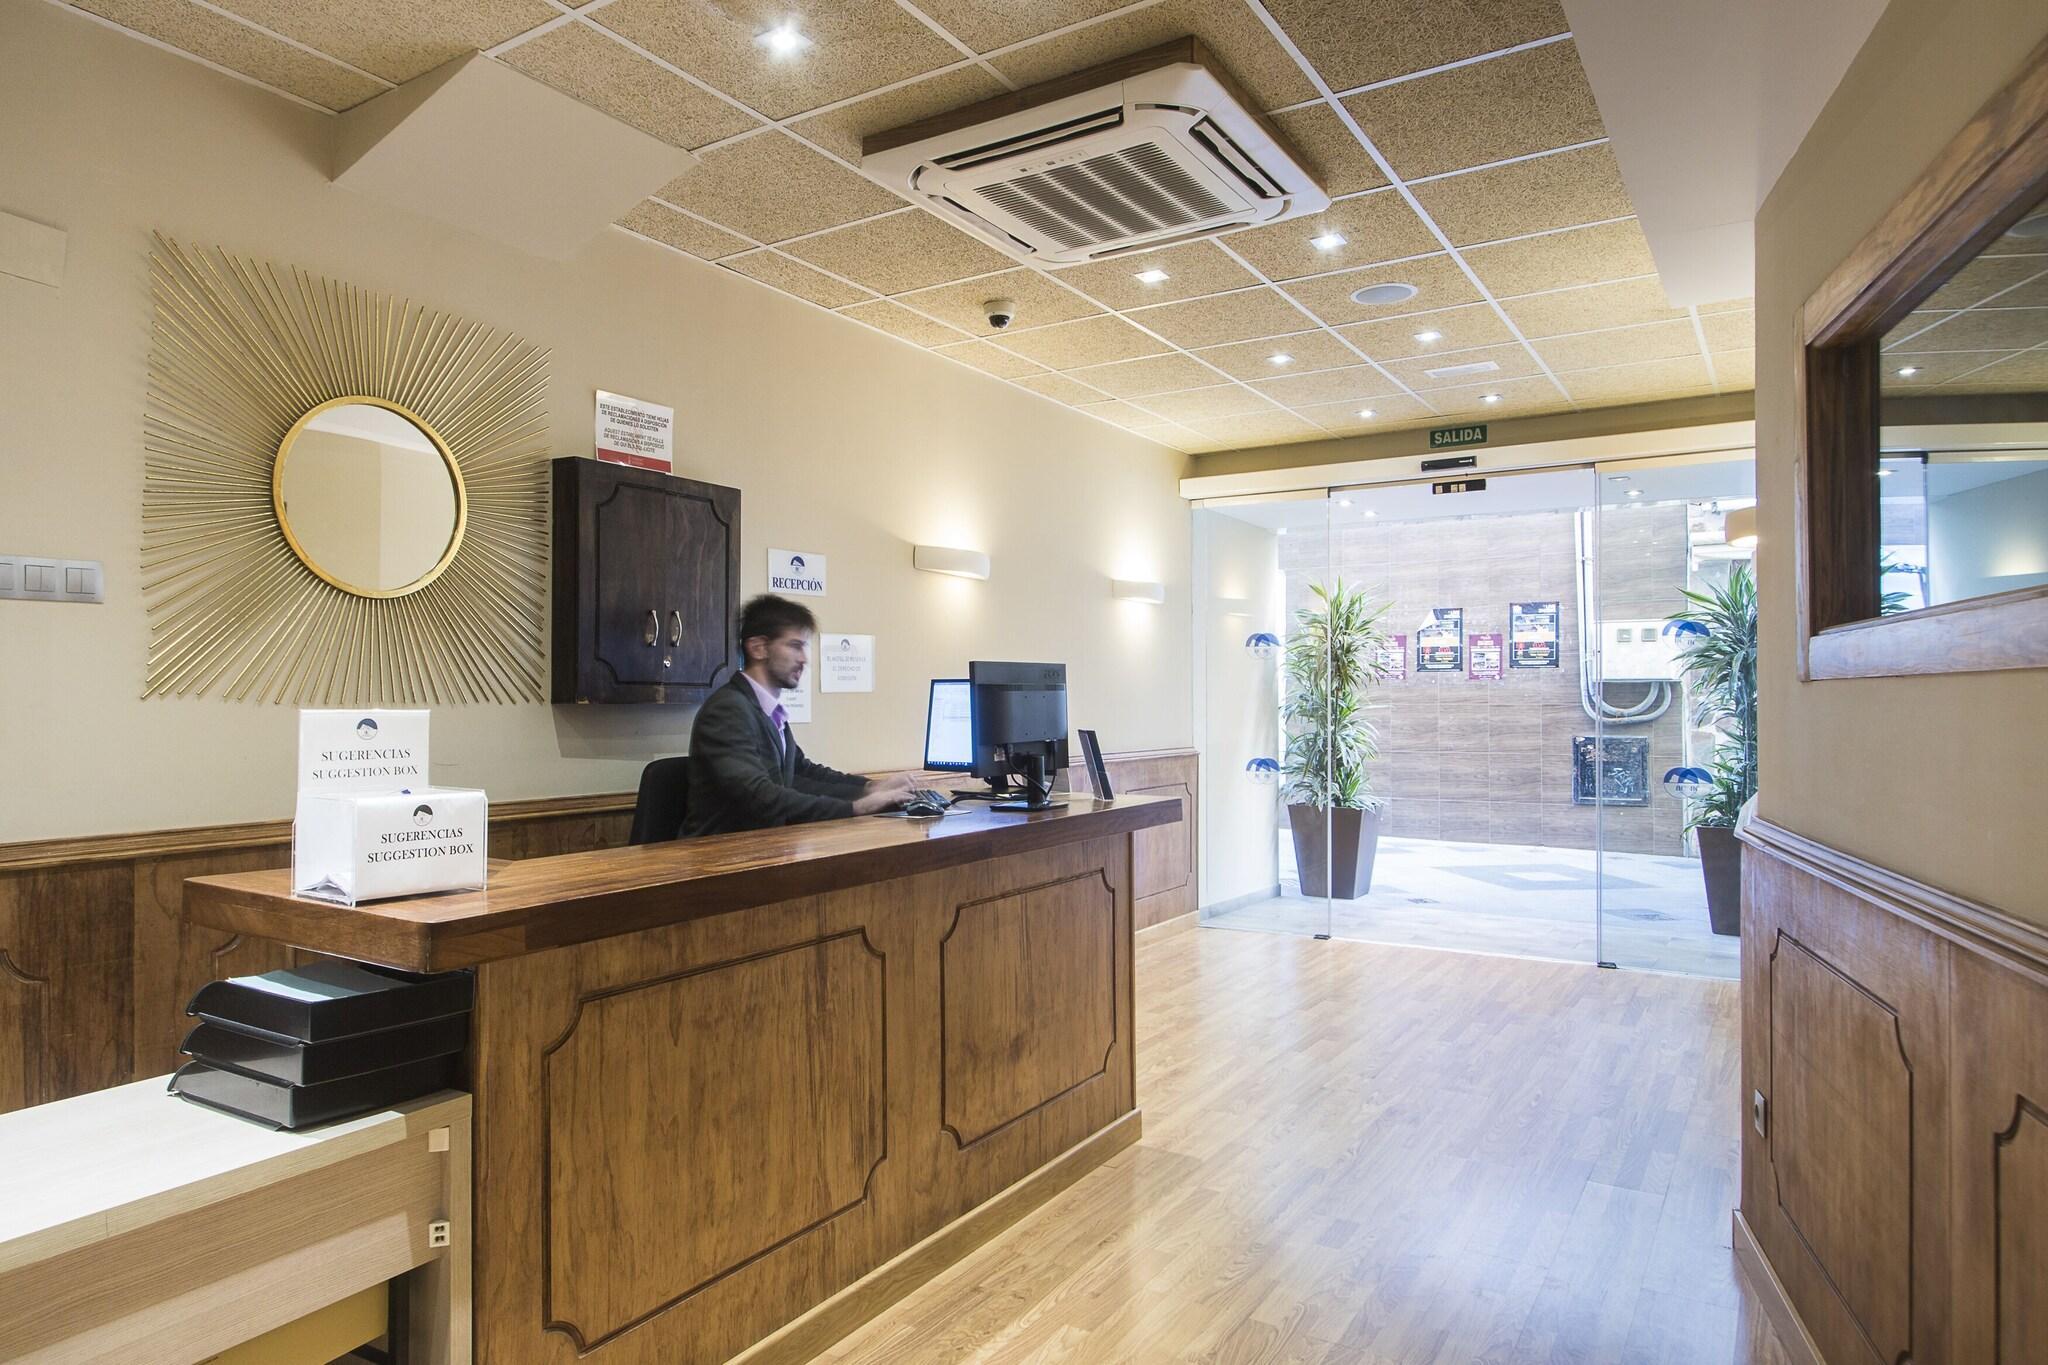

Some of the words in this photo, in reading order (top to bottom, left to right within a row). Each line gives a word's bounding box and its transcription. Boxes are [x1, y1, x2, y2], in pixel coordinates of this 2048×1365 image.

[1434, 427, 1482, 444] SALIDA
[772, 577, 823, 592] RECEPCIÓN
[321, 749, 411, 761] SUGERENCIAS
[312, 766, 391, 779] SUGGESTION
[393, 765, 418, 776] BOX
[380, 827, 463, 844] SUGERENCIAS
[367, 846, 446, 864] SUGGESTION
[449, 843, 474, 856] BOX
